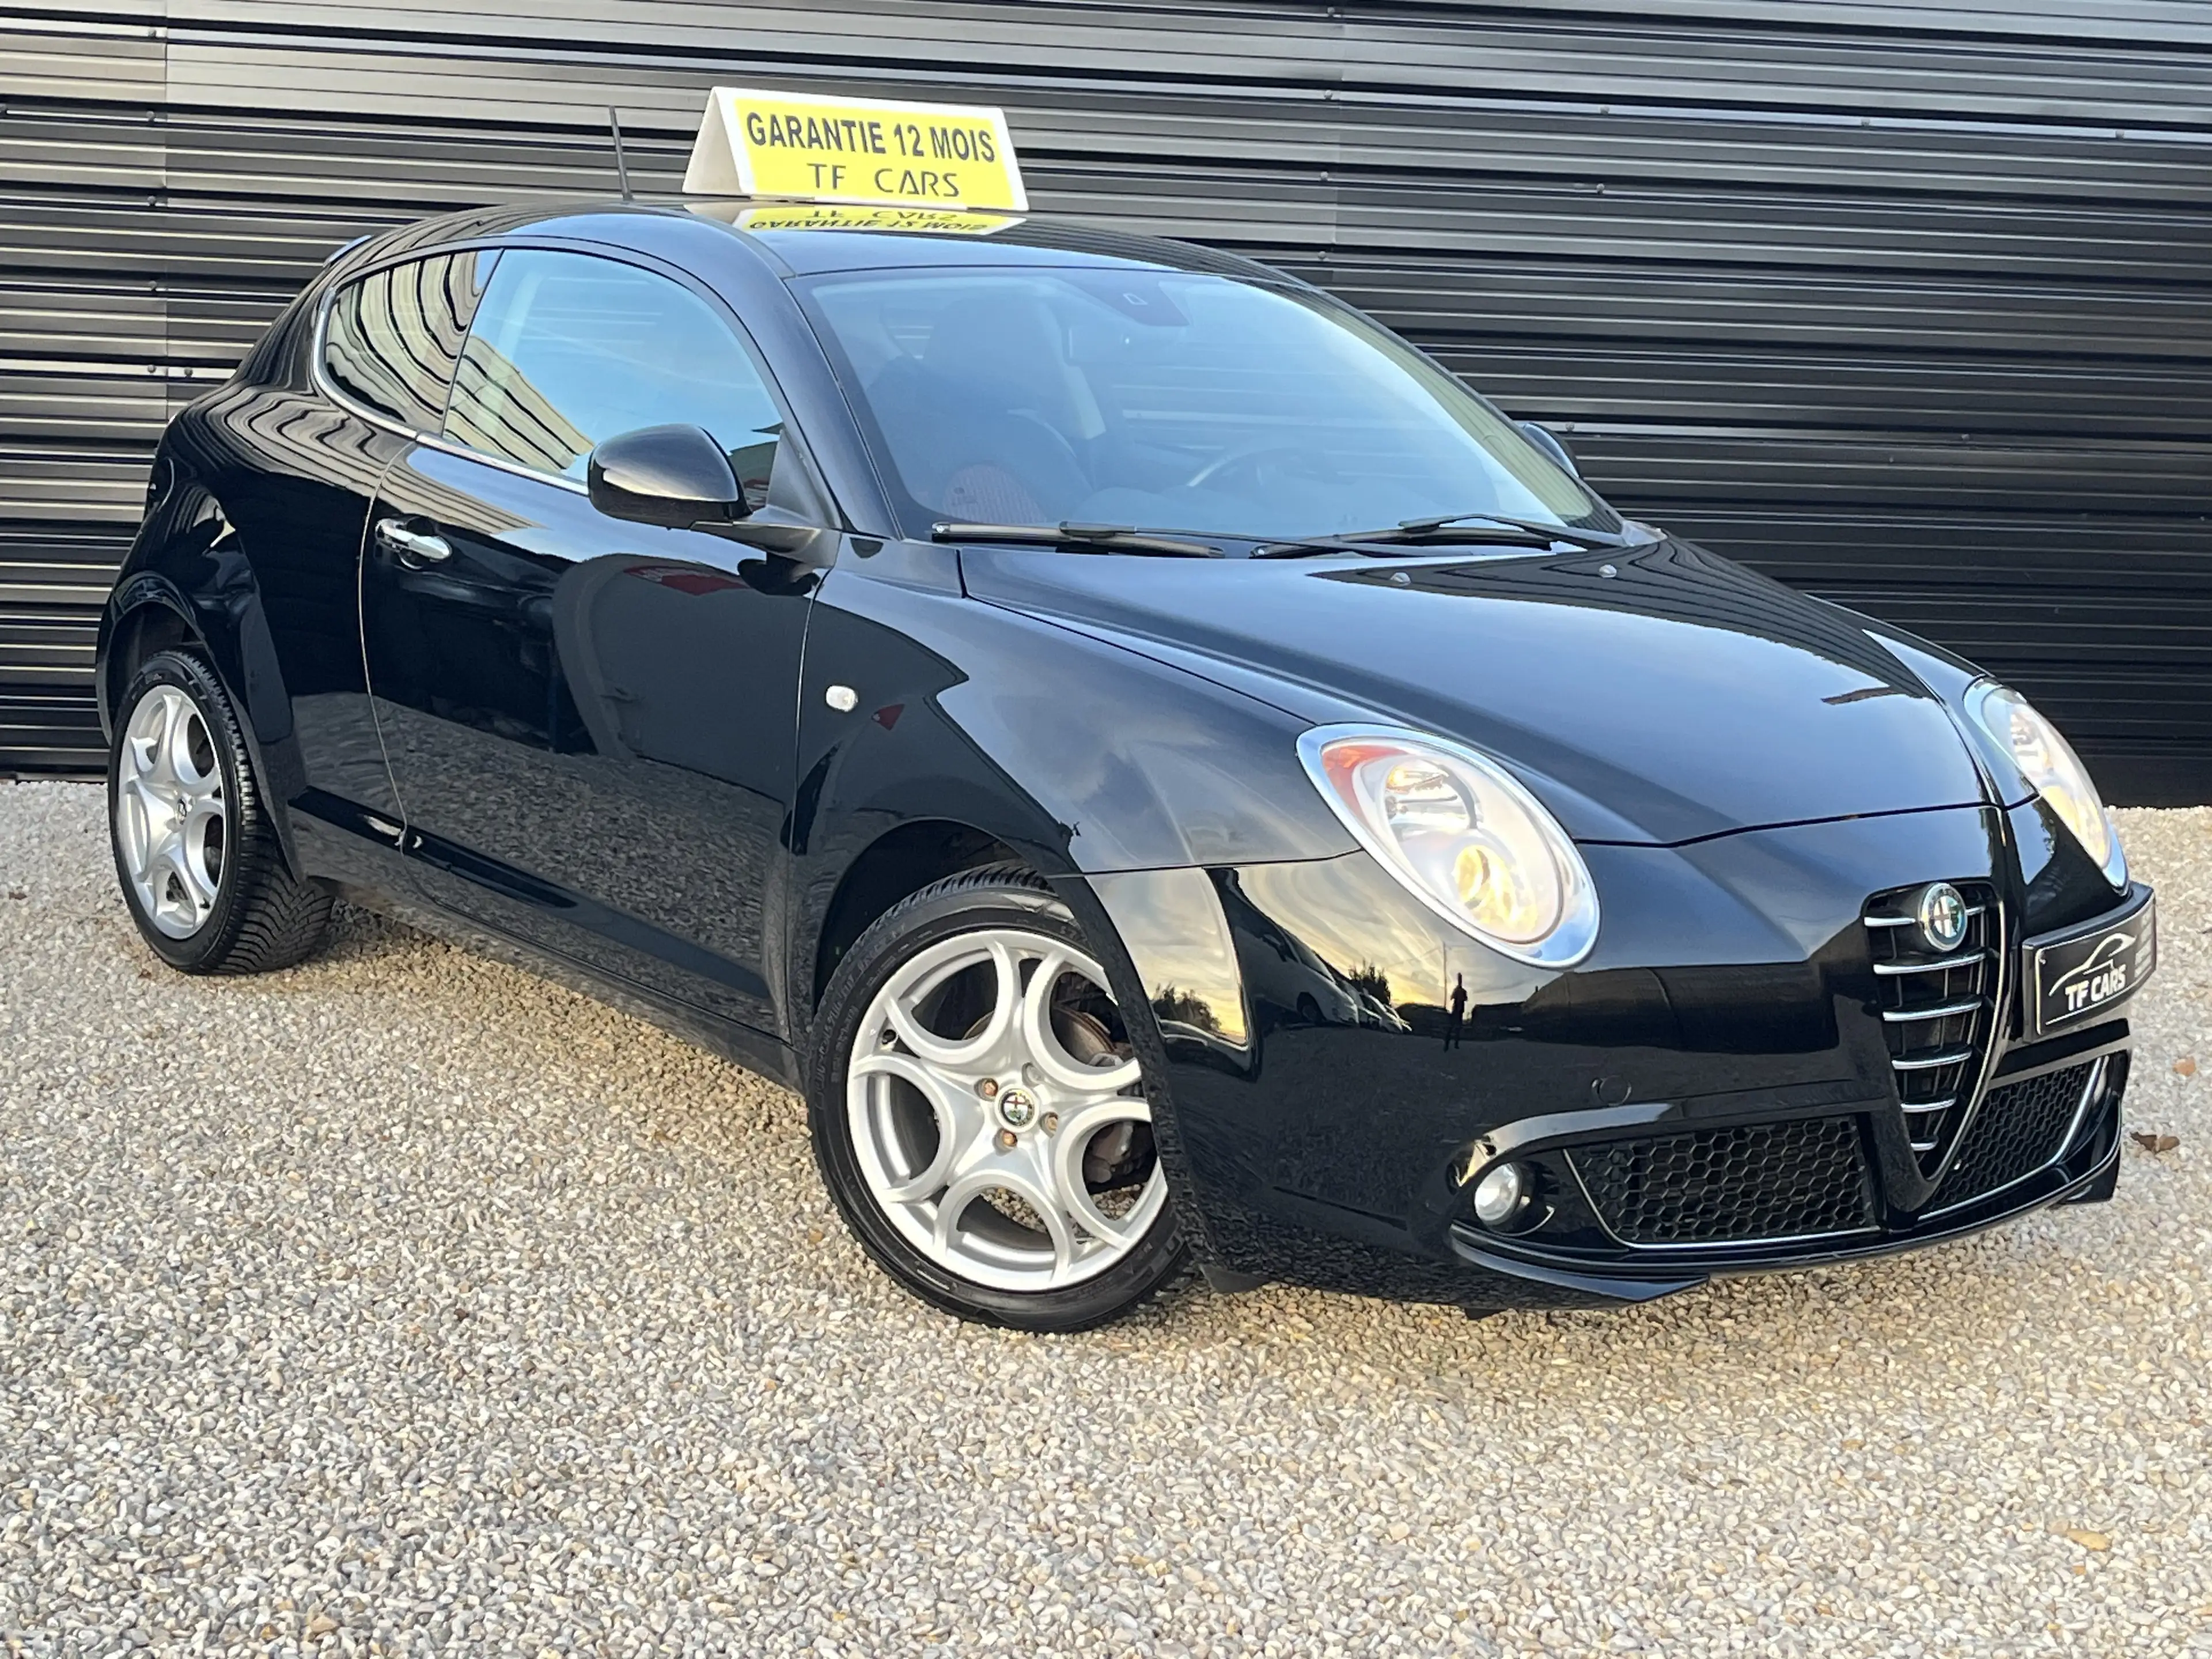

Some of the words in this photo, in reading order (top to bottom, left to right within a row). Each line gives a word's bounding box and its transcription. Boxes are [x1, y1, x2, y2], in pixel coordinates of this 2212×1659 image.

[747, 112, 887, 154] GARANTIE
[893, 123, 925, 157] 12
[929, 126, 995, 162] MOIS
[806, 163, 846, 190] TF
[874, 168, 959, 197] CARS
[2065, 980, 2089, 1011] TF
[2090, 964, 2127, 1002] CARS
